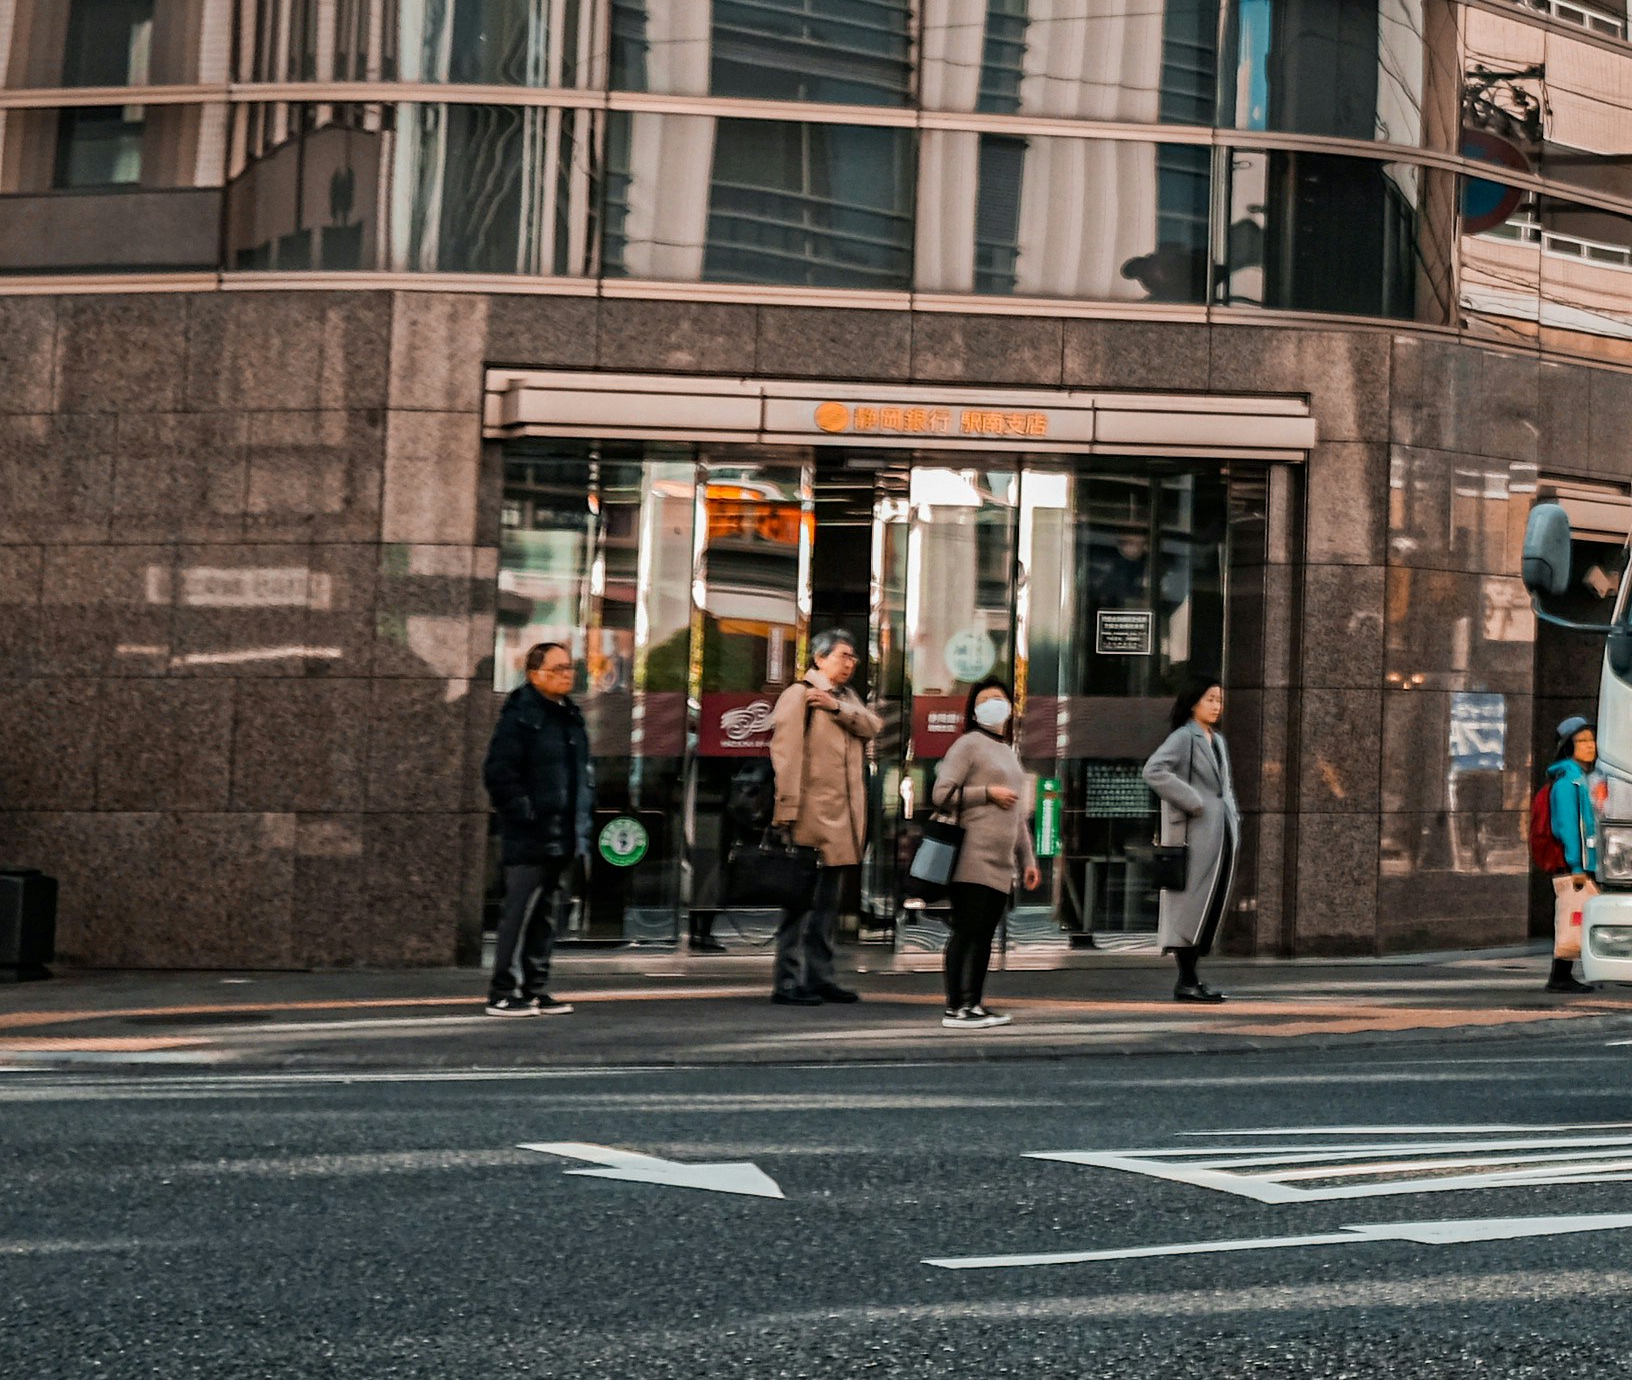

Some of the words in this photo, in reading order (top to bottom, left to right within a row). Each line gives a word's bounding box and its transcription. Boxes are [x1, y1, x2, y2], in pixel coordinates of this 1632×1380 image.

[853, 406, 952, 434] 静岡銀行
[960, 409, 1048, 436] 駅南支店
